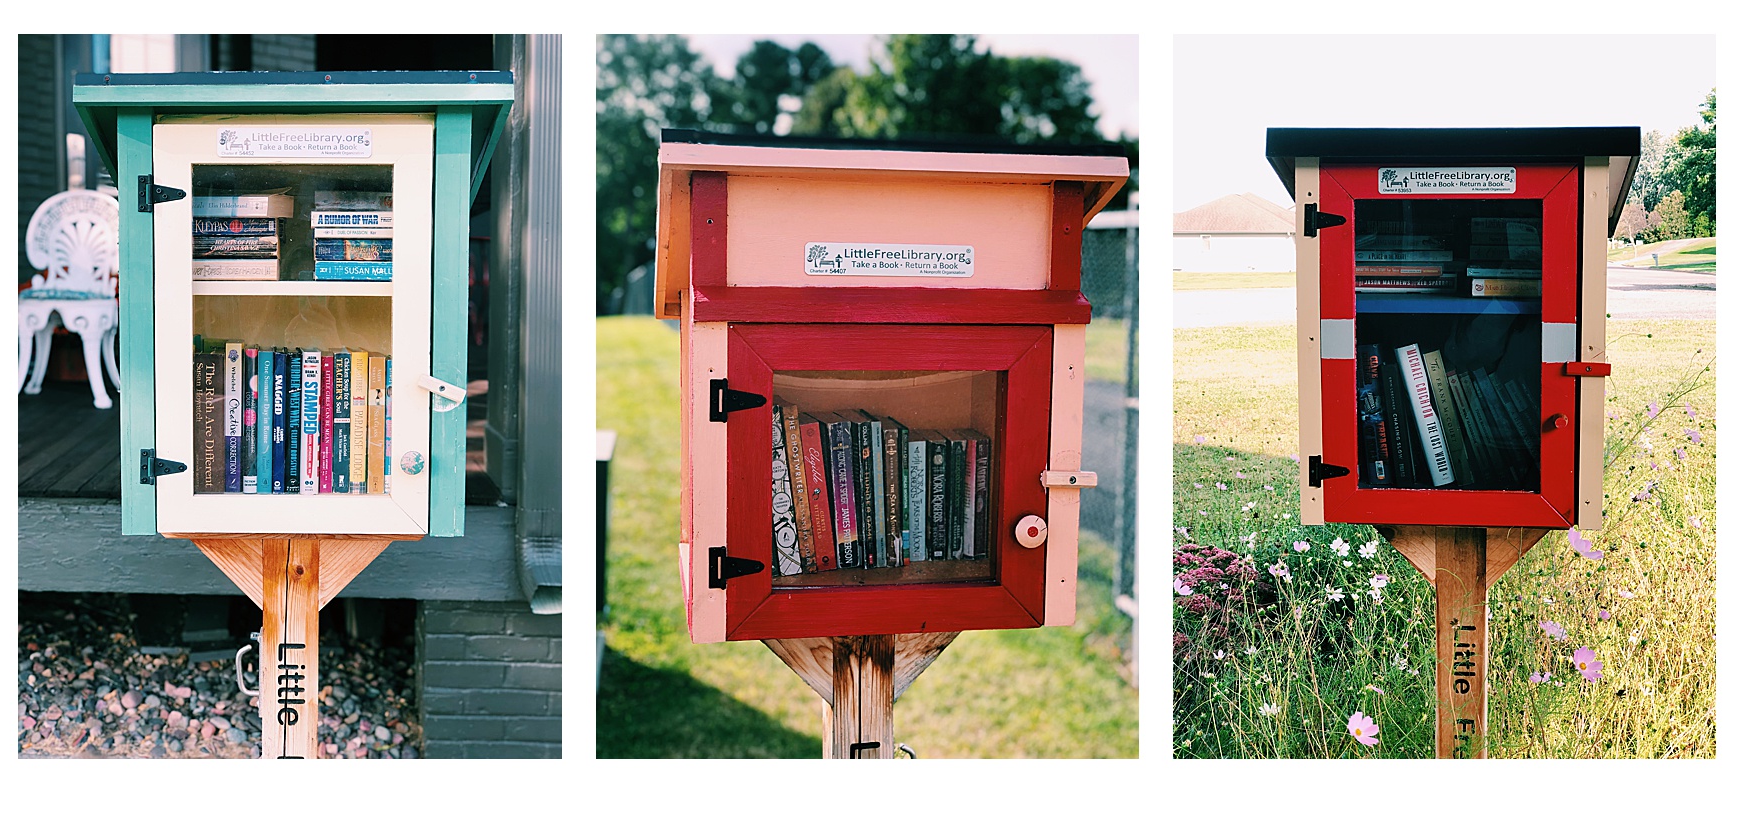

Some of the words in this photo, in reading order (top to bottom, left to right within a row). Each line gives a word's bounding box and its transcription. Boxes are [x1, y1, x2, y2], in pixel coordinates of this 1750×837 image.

[252, 132, 364, 144] LittleFreeLibrary.org
[1410, 171, 1510, 181] LittleFreeLibrary.org
[195, 219, 229, 234] KLEYPAS
[318, 214, 323, 225] A
[324, 214, 351, 225] RUMOR
[352, 214, 360, 225] OF
[362, 214, 379, 225] WAR
[844, 248, 966, 262] LittleFreeLibrary.org
[940, 262, 958, 270] Book
[344, 266, 370, 275] SUSAN
[196, 362, 204, 386] Susan
[204, 362, 216, 385] The
[291, 357, 301, 388] MURDER
[1406, 348, 1424, 380] MICHAEL
[205, 388, 216, 413] Rich
[274, 374, 283, 416] SNAGGED
[290, 392, 300, 408] WEST
[1416, 383, 1434, 419] CRICHTON
[1436, 378, 1447, 404] FRANK
[196, 389, 204, 422] Howatch
[228, 398, 240, 436] Creative
[262, 404, 270, 417] Day
[304, 381, 318, 434] STAMPED
[205, 416, 215, 436] Are
[290, 410, 300, 428] WING
[354, 410, 364, 449] PARADISE
[1426, 421, 1437, 434] THE
[290, 430, 298, 449] ELLIOTT
[1392, 413, 1400, 440] CHASING
[1396, 442, 1404, 460] SLOW
[1429, 436, 1442, 450] LOST
[205, 440, 216, 488] Different
[290, 450, 298, 476] ROOSEVELT
[354, 454, 363, 478] LODGE
[790, 434, 804, 494] GHOSTWRITER
[804, 447, 823, 484] Eligible
[838, 451, 846, 468] ALONG
[1434, 452, 1448, 472] WORLD
[838, 468, 846, 483] CAME
[910, 466, 918, 498] ROBERTS
[932, 474, 944, 493] NORA
[840, 488, 848, 505] SPIDER
[912, 499, 922, 517] TEARS
[932, 494, 944, 522] ROBERTS
[841, 508, 850, 529] JAMES
[843, 530, 853, 564] PATTERSON
[912, 531, 922, 552] MOON
[1453, 625, 1476, 695] Little
[277, 643, 306, 726] Little
